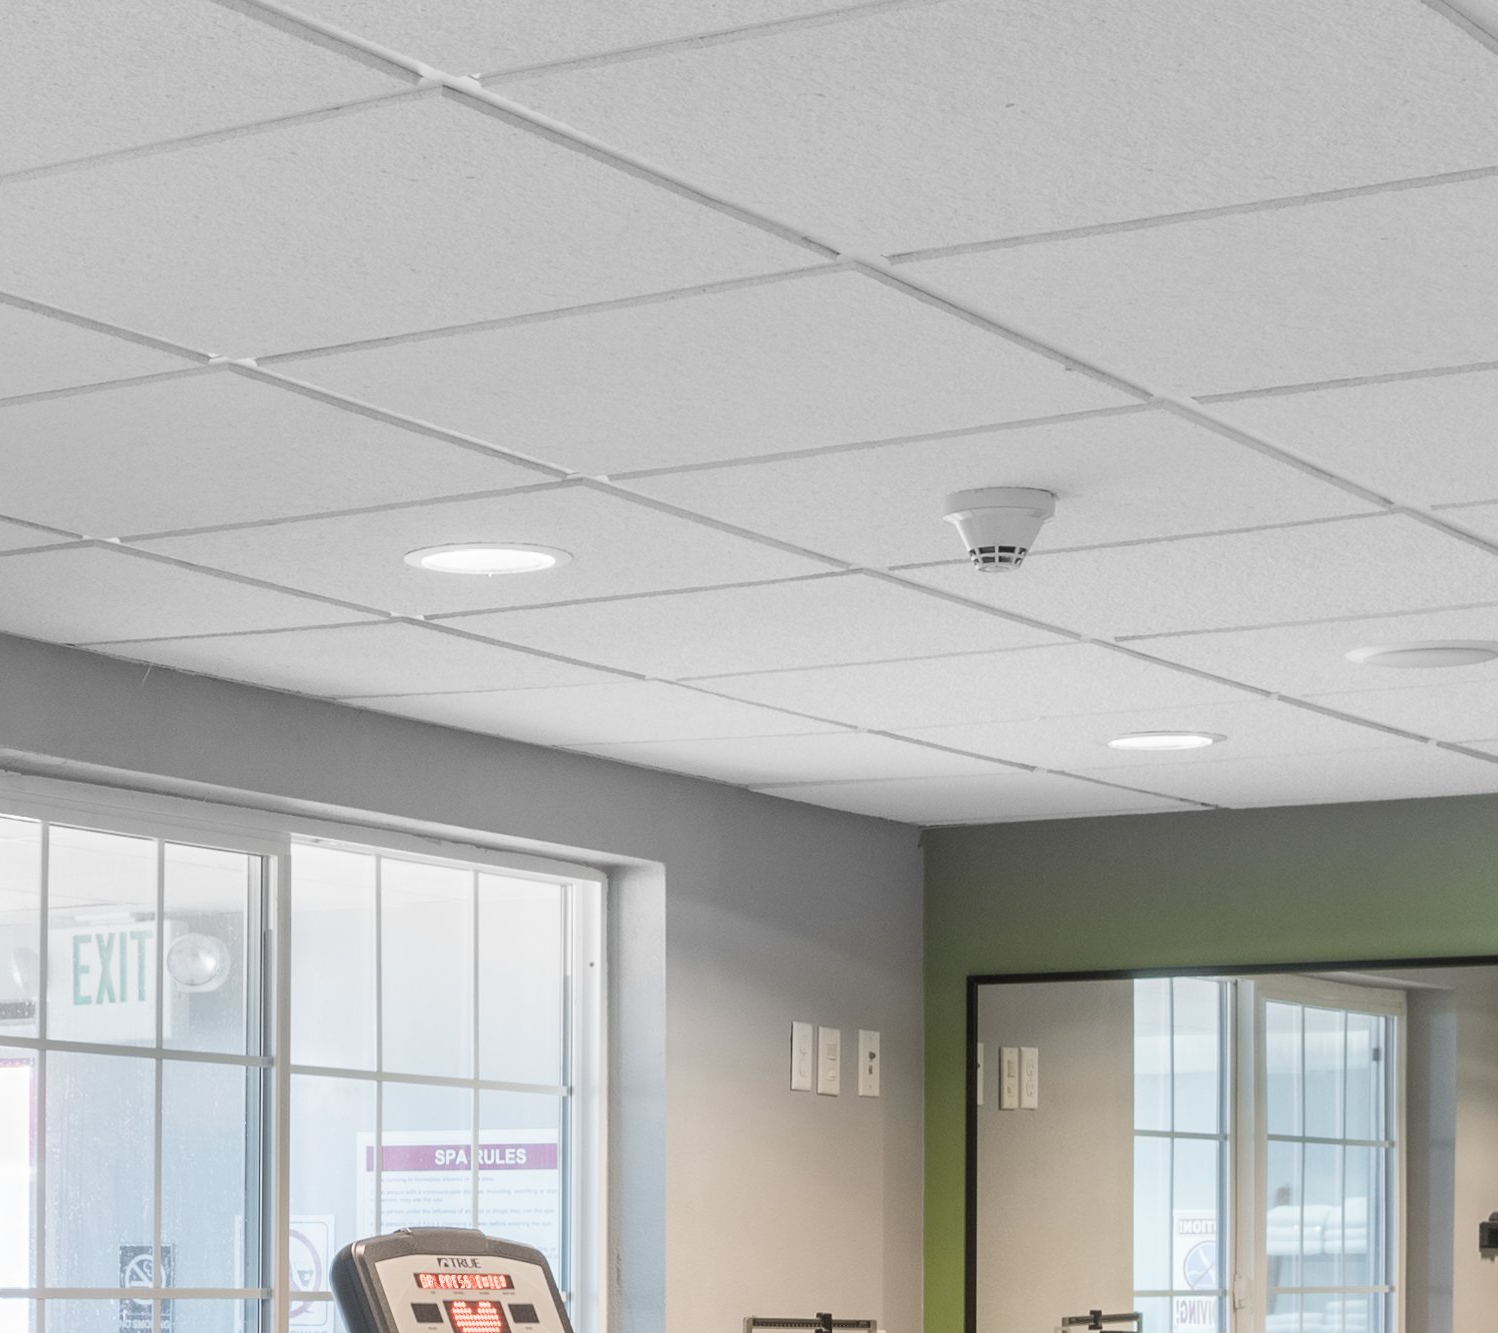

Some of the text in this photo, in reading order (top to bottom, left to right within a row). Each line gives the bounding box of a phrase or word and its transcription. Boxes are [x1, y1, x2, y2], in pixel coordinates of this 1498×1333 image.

[72, 930, 152, 1005] EXIT
[435, 1148, 527, 1165] SPA RULES
[450, 1258, 482, 1269] TRUE
[133, 1319, 171, 1330] SMONG
